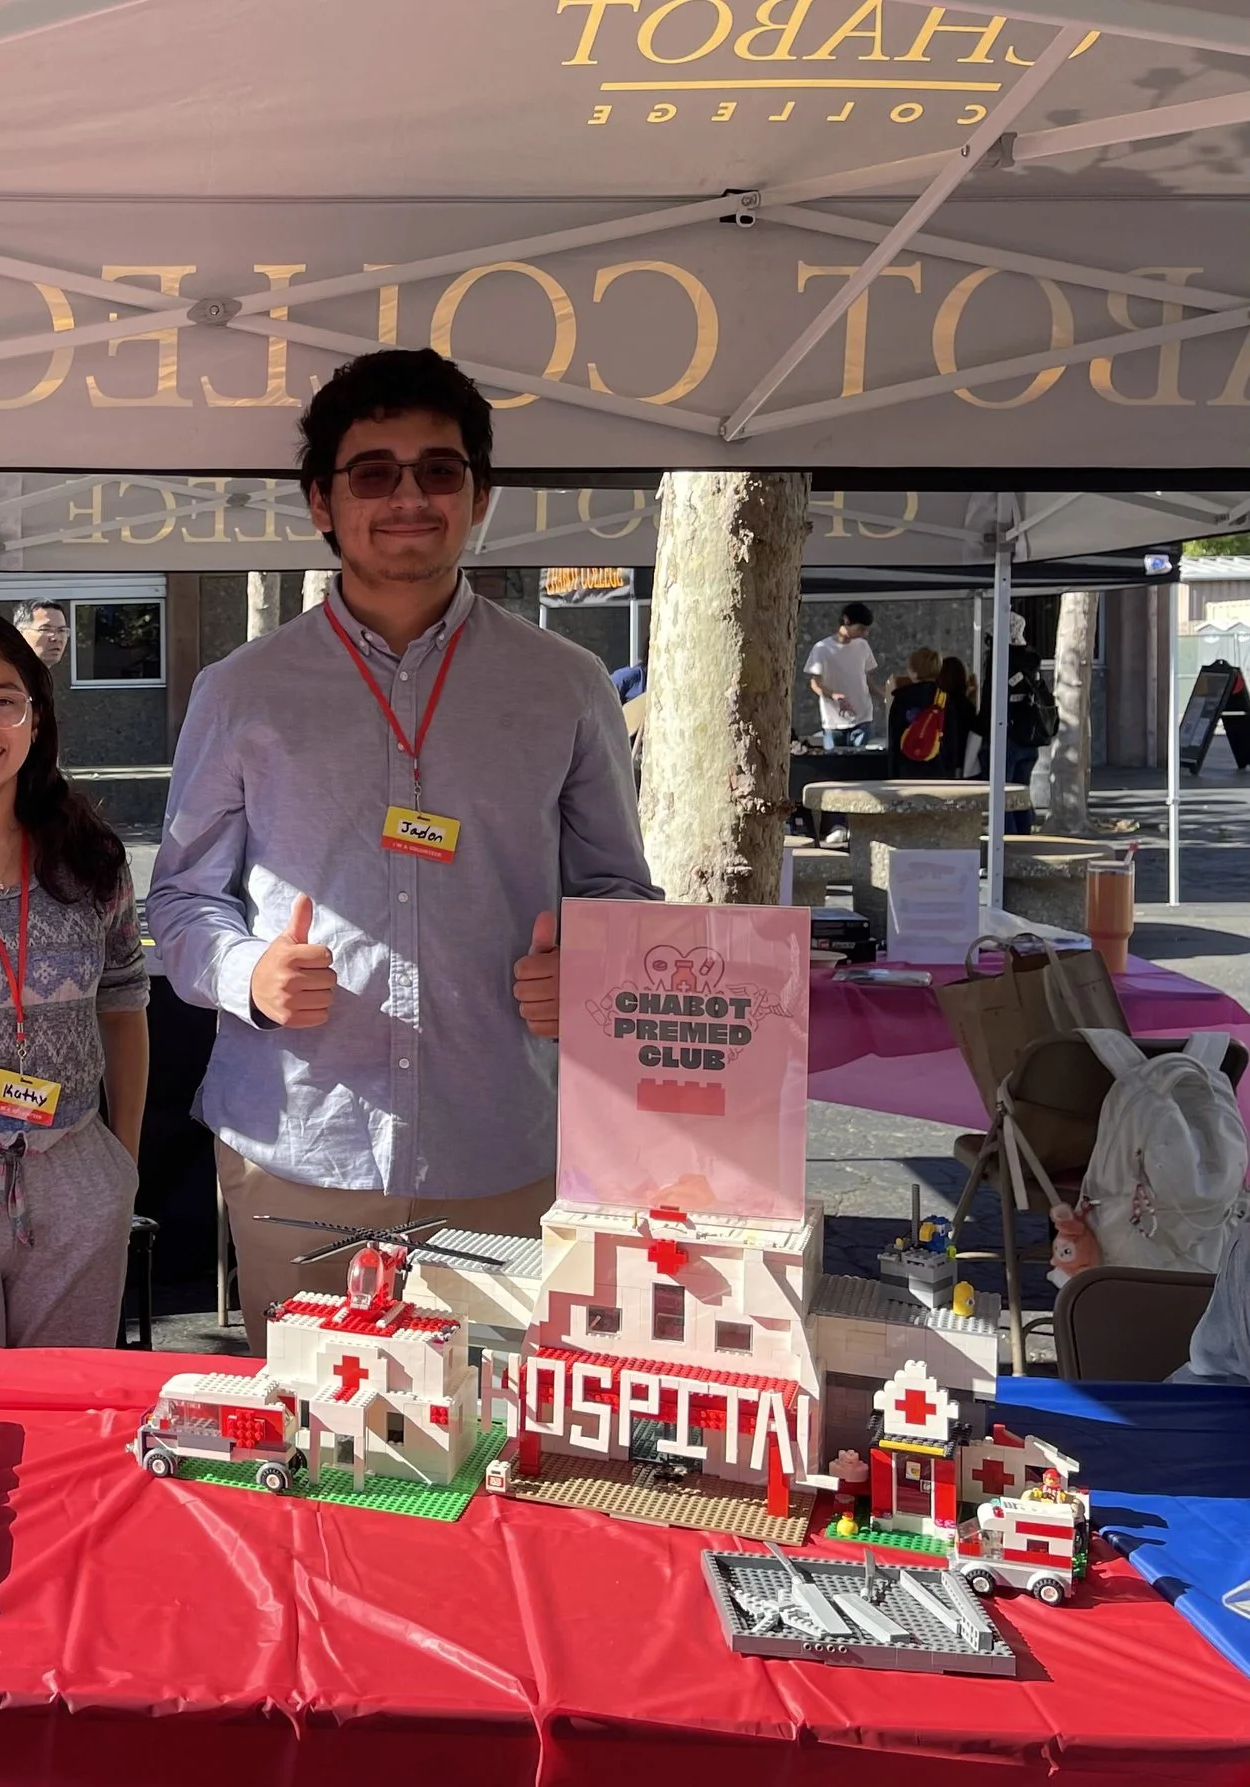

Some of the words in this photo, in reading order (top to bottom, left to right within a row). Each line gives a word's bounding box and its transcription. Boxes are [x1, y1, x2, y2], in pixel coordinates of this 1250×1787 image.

[615, 991, 752, 1020] CHABOT
[613, 1018, 753, 1046] PREMED
[638, 1045, 726, 1071] CLUB
[3, 1083, 47, 1107] Kathy
[481, 1348, 840, 1491] HOSPITAL
